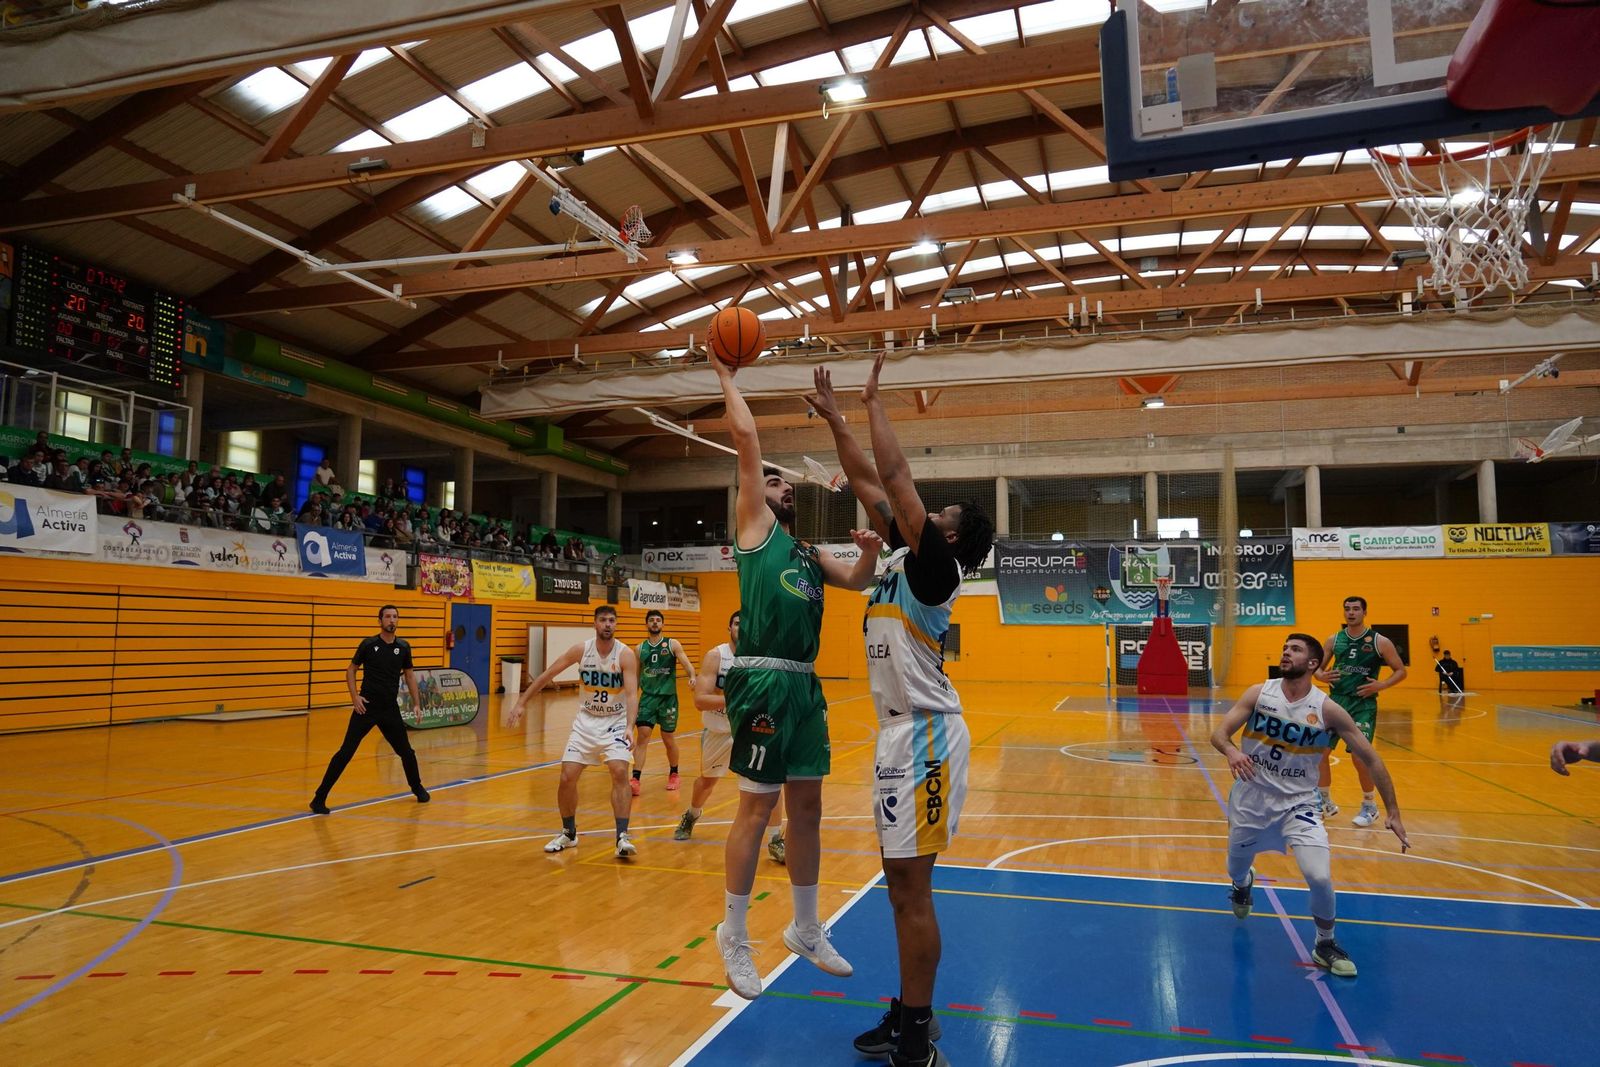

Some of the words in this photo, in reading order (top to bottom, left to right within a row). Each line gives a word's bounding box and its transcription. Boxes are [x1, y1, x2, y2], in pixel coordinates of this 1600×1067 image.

[66, 280, 91, 295] LOCAL
[66, 293, 88, 313] 20
[127, 312, 145, 331] 20
[42, 518, 86, 532] Activa
[1363, 535, 1437, 546] CAMPOEJIDO
[1473, 526, 1537, 542] NOCTUA
[333, 550, 357, 561] Activa
[657, 551, 684, 562] nex
[832, 550, 860, 559] OSOL
[553, 577, 583, 591] INDUSER
[796, 577, 823, 601] FitoS
[639, 589, 668, 605] agroclean
[1232, 602, 1286, 616] Bioline
[1119, 640, 1206, 656] POER
[1348, 648, 1358, 660] 5
[651, 653, 658, 663] 0
[580, 670, 624, 689] CBCM
[593, 690, 609, 704] 28
[1253, 711, 1323, 747] CBCM
[747, 743, 767, 771] 11
[1269, 743, 1286, 761] 6
[1281, 767, 1307, 779] OLEA
[923, 759, 943, 826] CBCM
